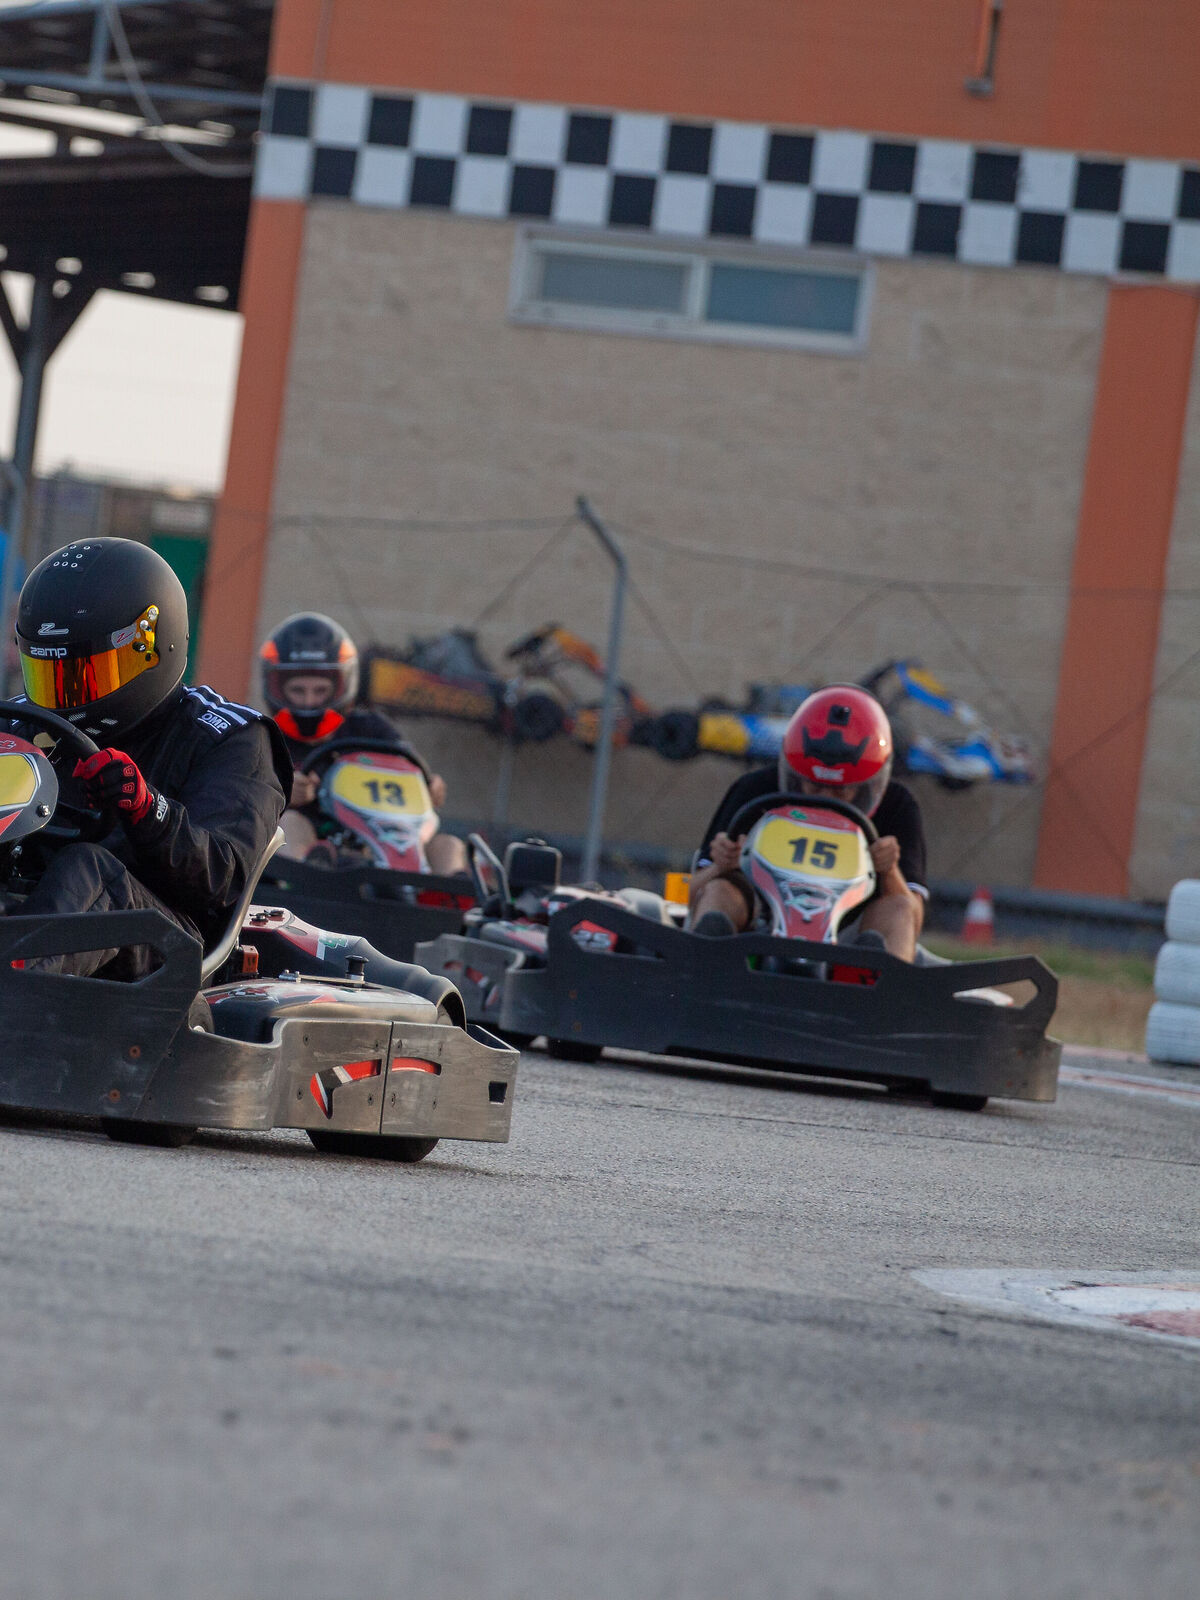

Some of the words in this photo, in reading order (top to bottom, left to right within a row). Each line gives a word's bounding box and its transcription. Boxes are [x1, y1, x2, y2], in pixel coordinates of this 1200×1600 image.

[29, 646, 67, 659] zamp
[201, 712, 229, 730] OMP
[362, 780, 406, 807] 13
[788, 837, 838, 870] 15
